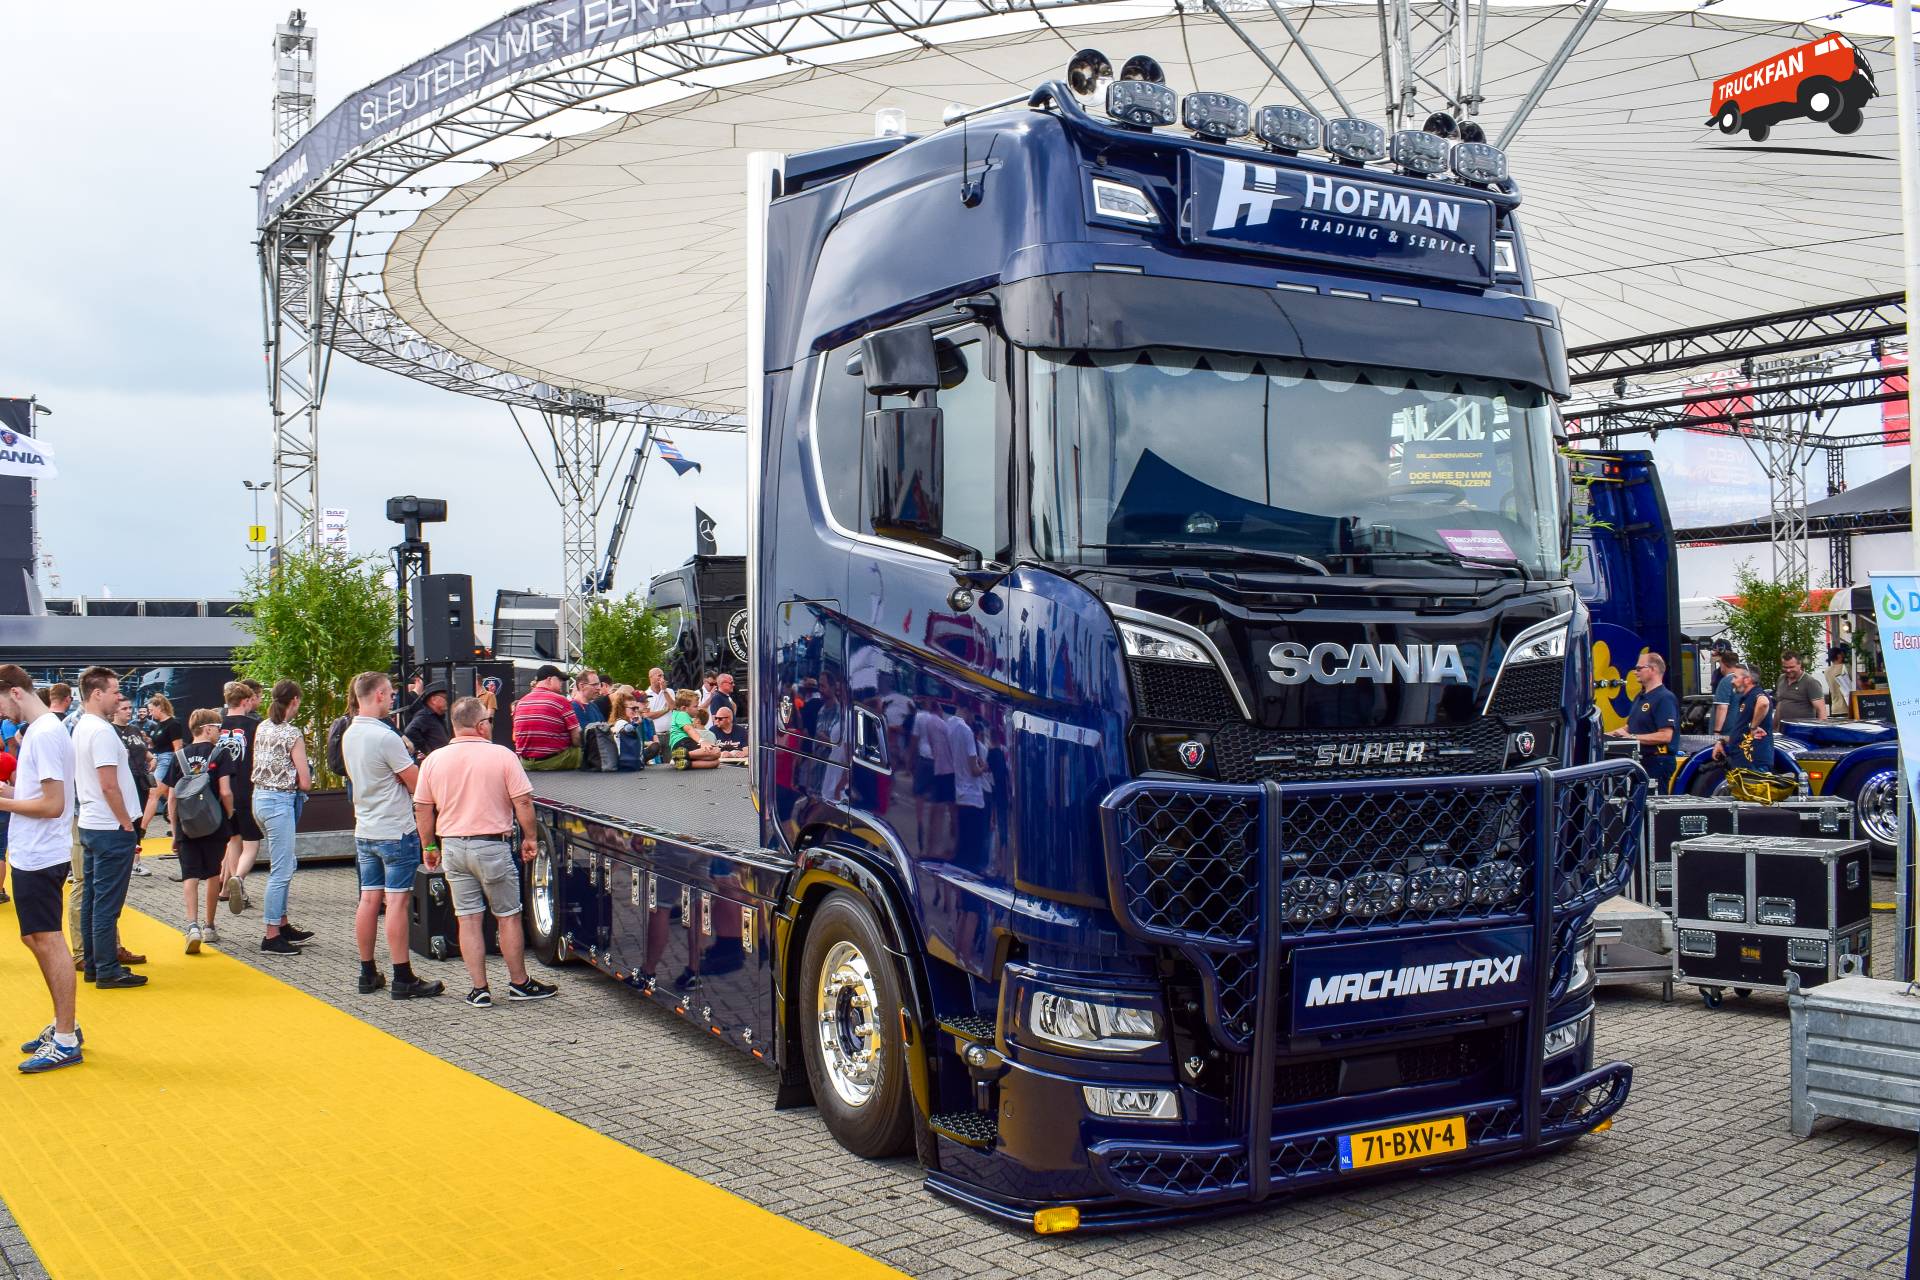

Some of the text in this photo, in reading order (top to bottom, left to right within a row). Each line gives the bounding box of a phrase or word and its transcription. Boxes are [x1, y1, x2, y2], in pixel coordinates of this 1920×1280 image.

[360, 37, 500, 131] SLEUTELEN
[505, 8, 576, 61] MET
[1304, 174, 1461, 232] HOFMAN
[1300, 217, 1477, 255] TRADING & SERVICE
[1409, 472, 1431, 480] DOE
[1893, 631, 1920, 650] Hen
[1267, 642, 1468, 685] SCANIA
[1314, 741, 1425, 767] SUPER
[1305, 955, 1521, 1007] MACHINETAXI
[1341, 1156, 1351, 1164] NL
[1362, 1123, 1455, 1161] 71-BXV-4
